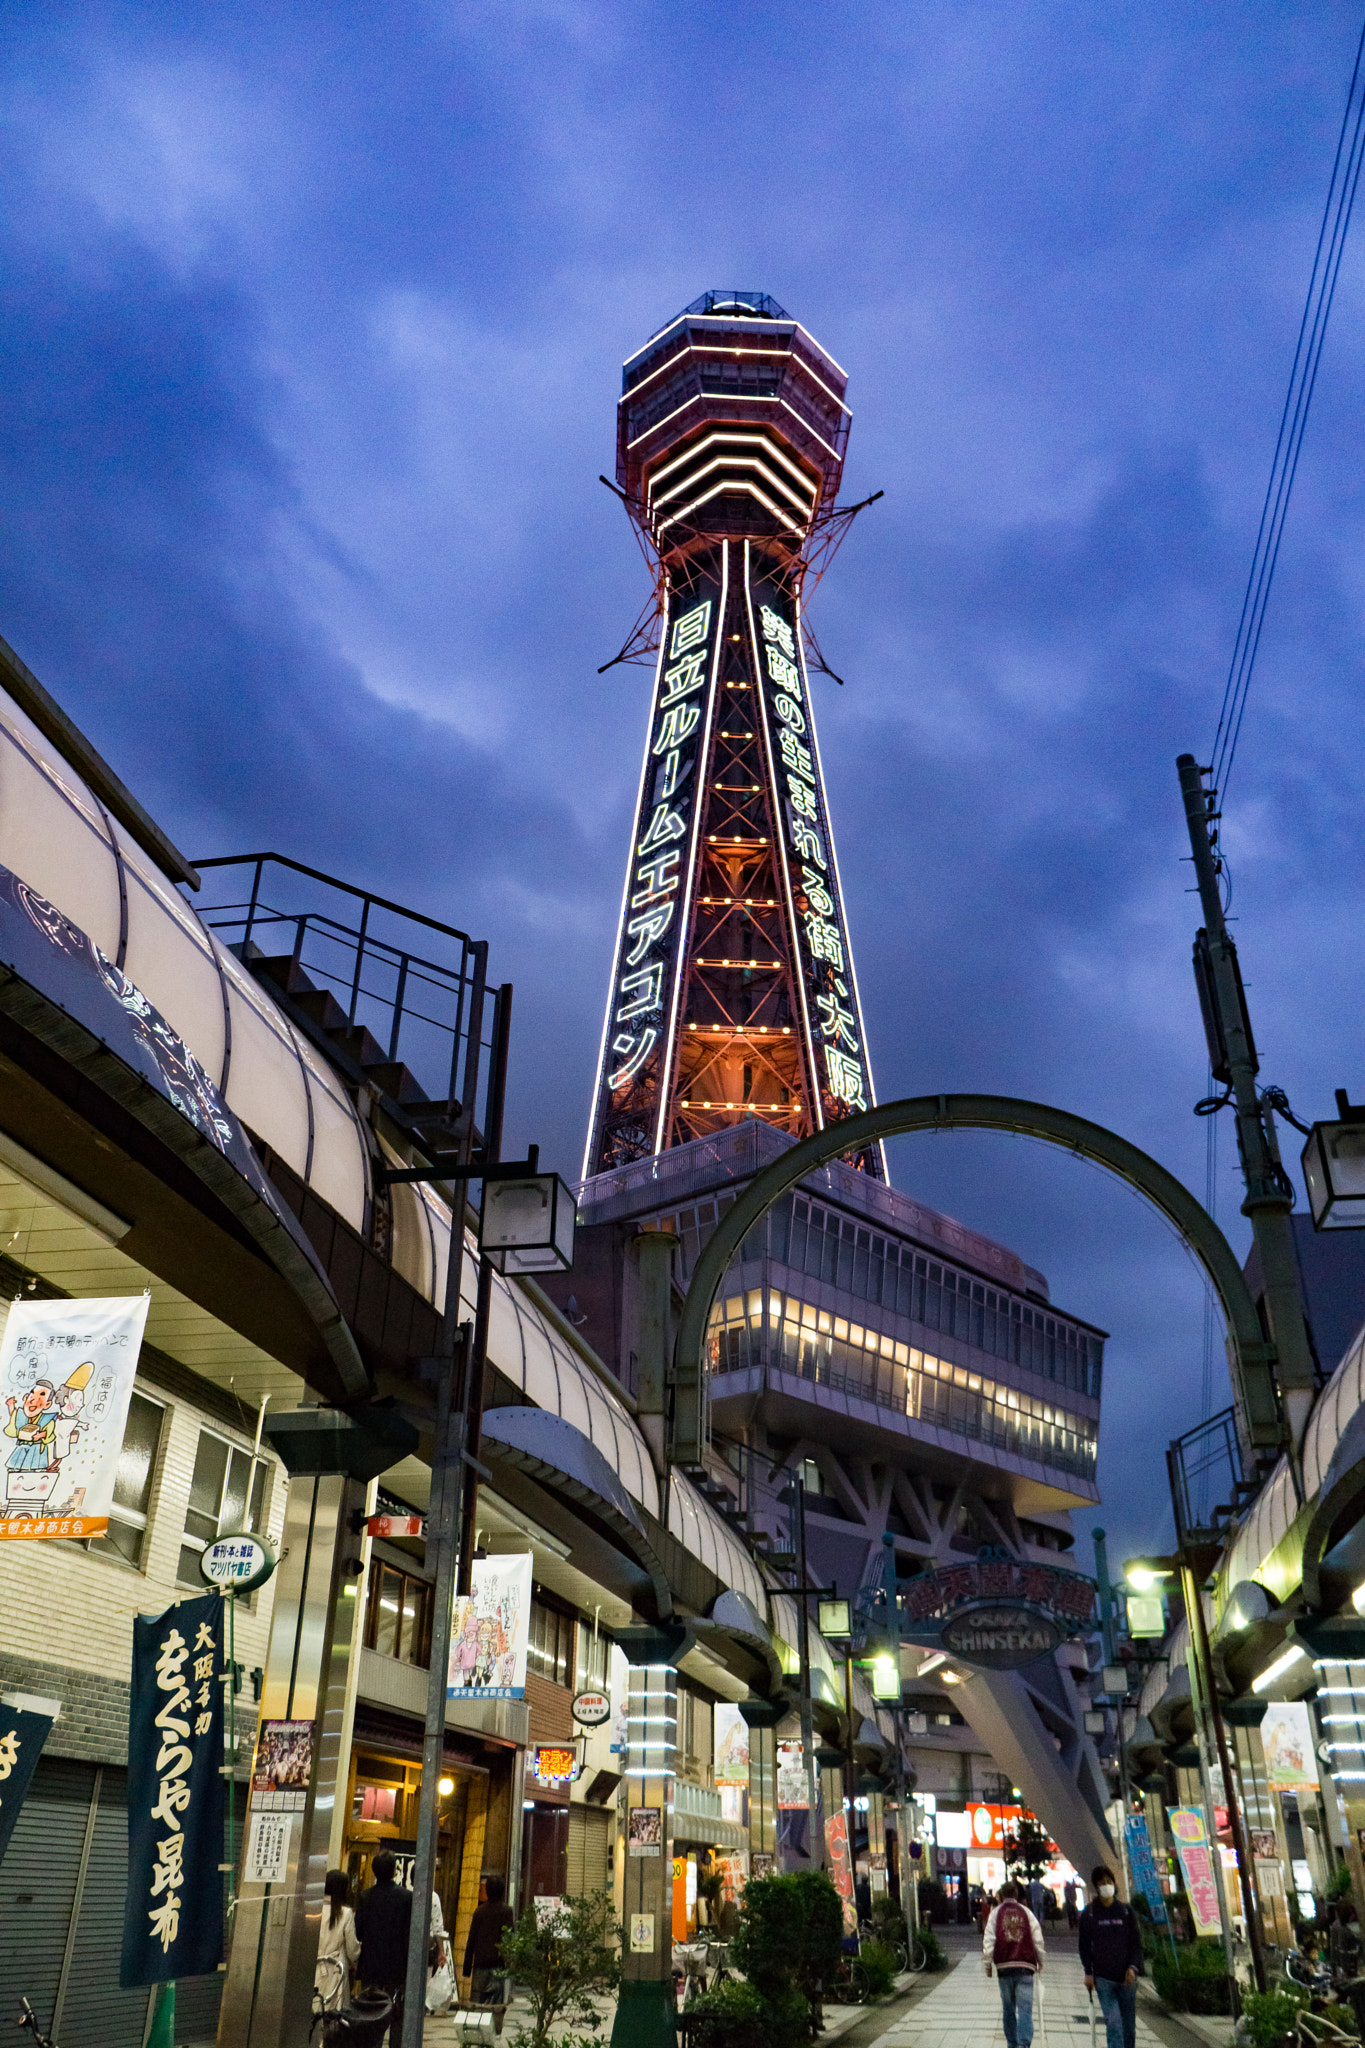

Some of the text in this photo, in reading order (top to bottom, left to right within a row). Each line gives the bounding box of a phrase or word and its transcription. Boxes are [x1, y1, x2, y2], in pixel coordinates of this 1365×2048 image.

[607, 599, 713, 1091] 日立ルームエアコン
[760, 604, 868, 1112] 笑顔の生まれる街、大阪
[210, 1560, 253, 1577] マツバヤ書店
[950, 1630, 1052, 1651] SHINSEKAI
[968, 1613, 1030, 1628] OSAKA
[148, 1628, 194, 1954] をぐらや昆布
